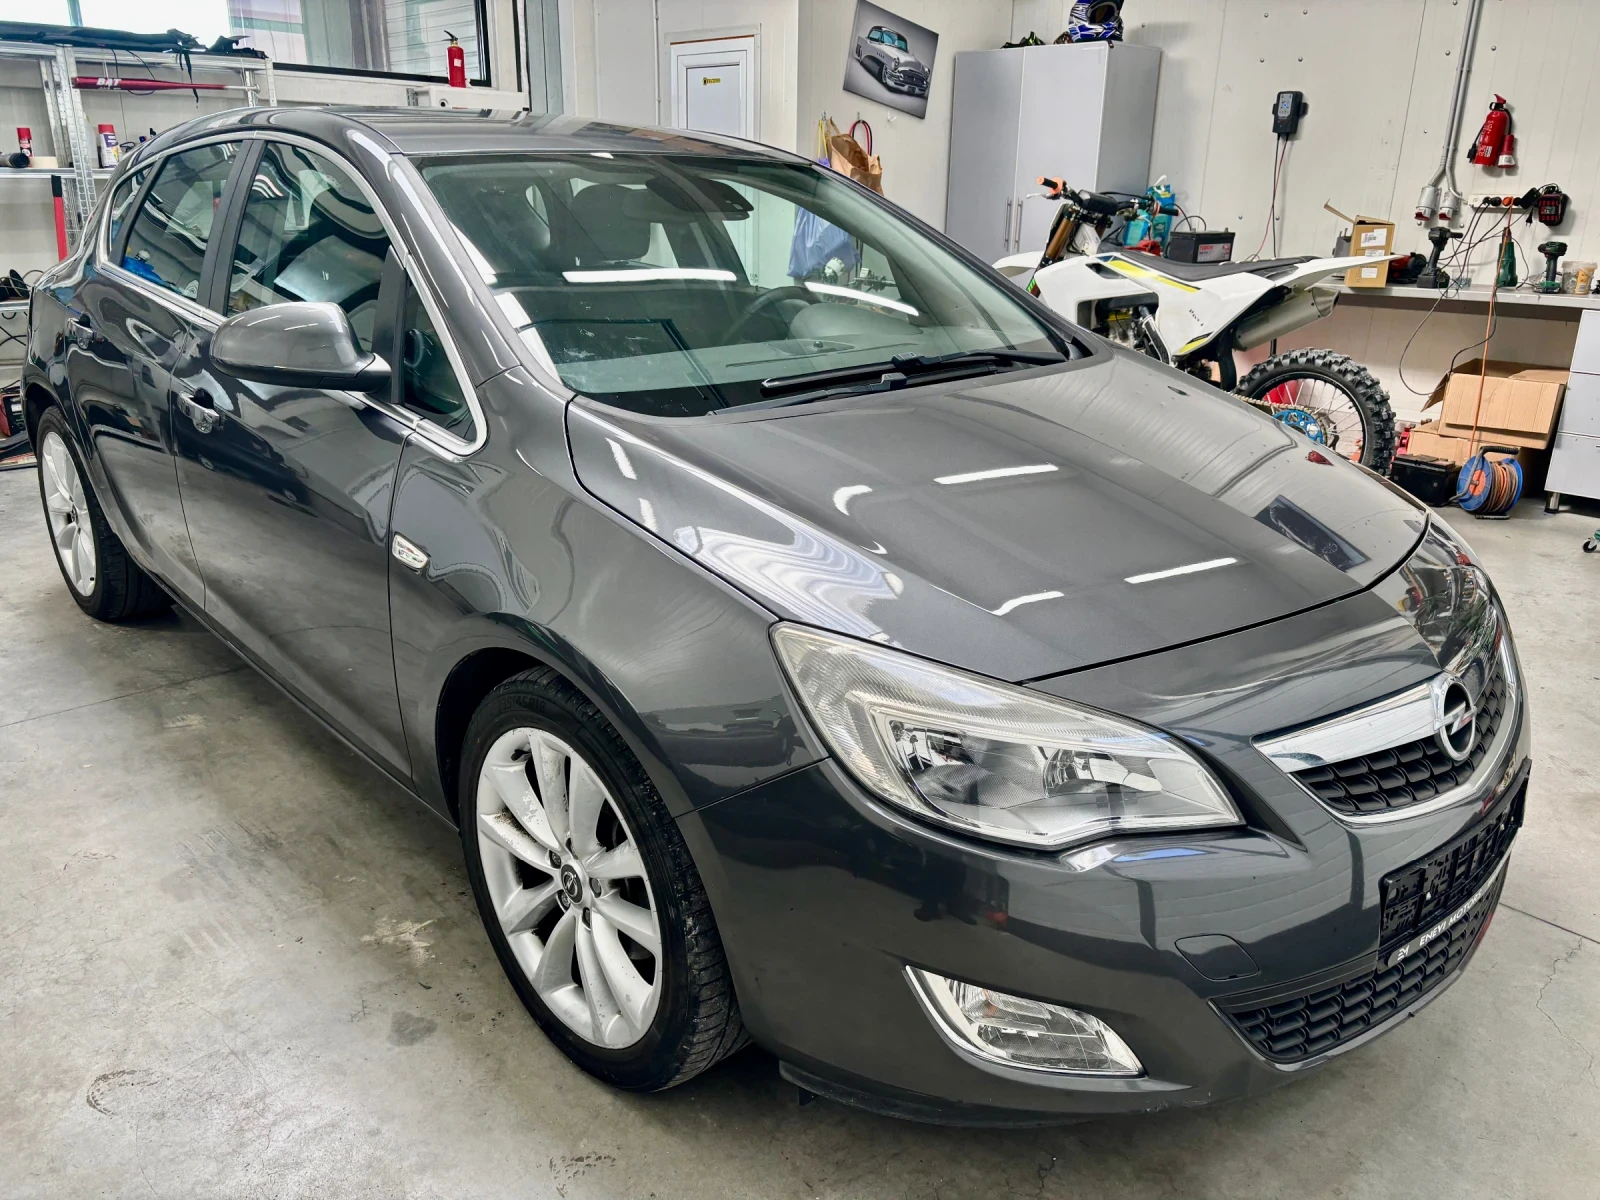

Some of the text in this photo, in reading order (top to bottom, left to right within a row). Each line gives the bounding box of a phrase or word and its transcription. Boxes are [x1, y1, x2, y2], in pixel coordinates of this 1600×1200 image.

[96, 78, 122, 86] BAT
[1419, 920, 1447, 947] ENEVI
[1448, 888, 1483, 926] MOTORS
